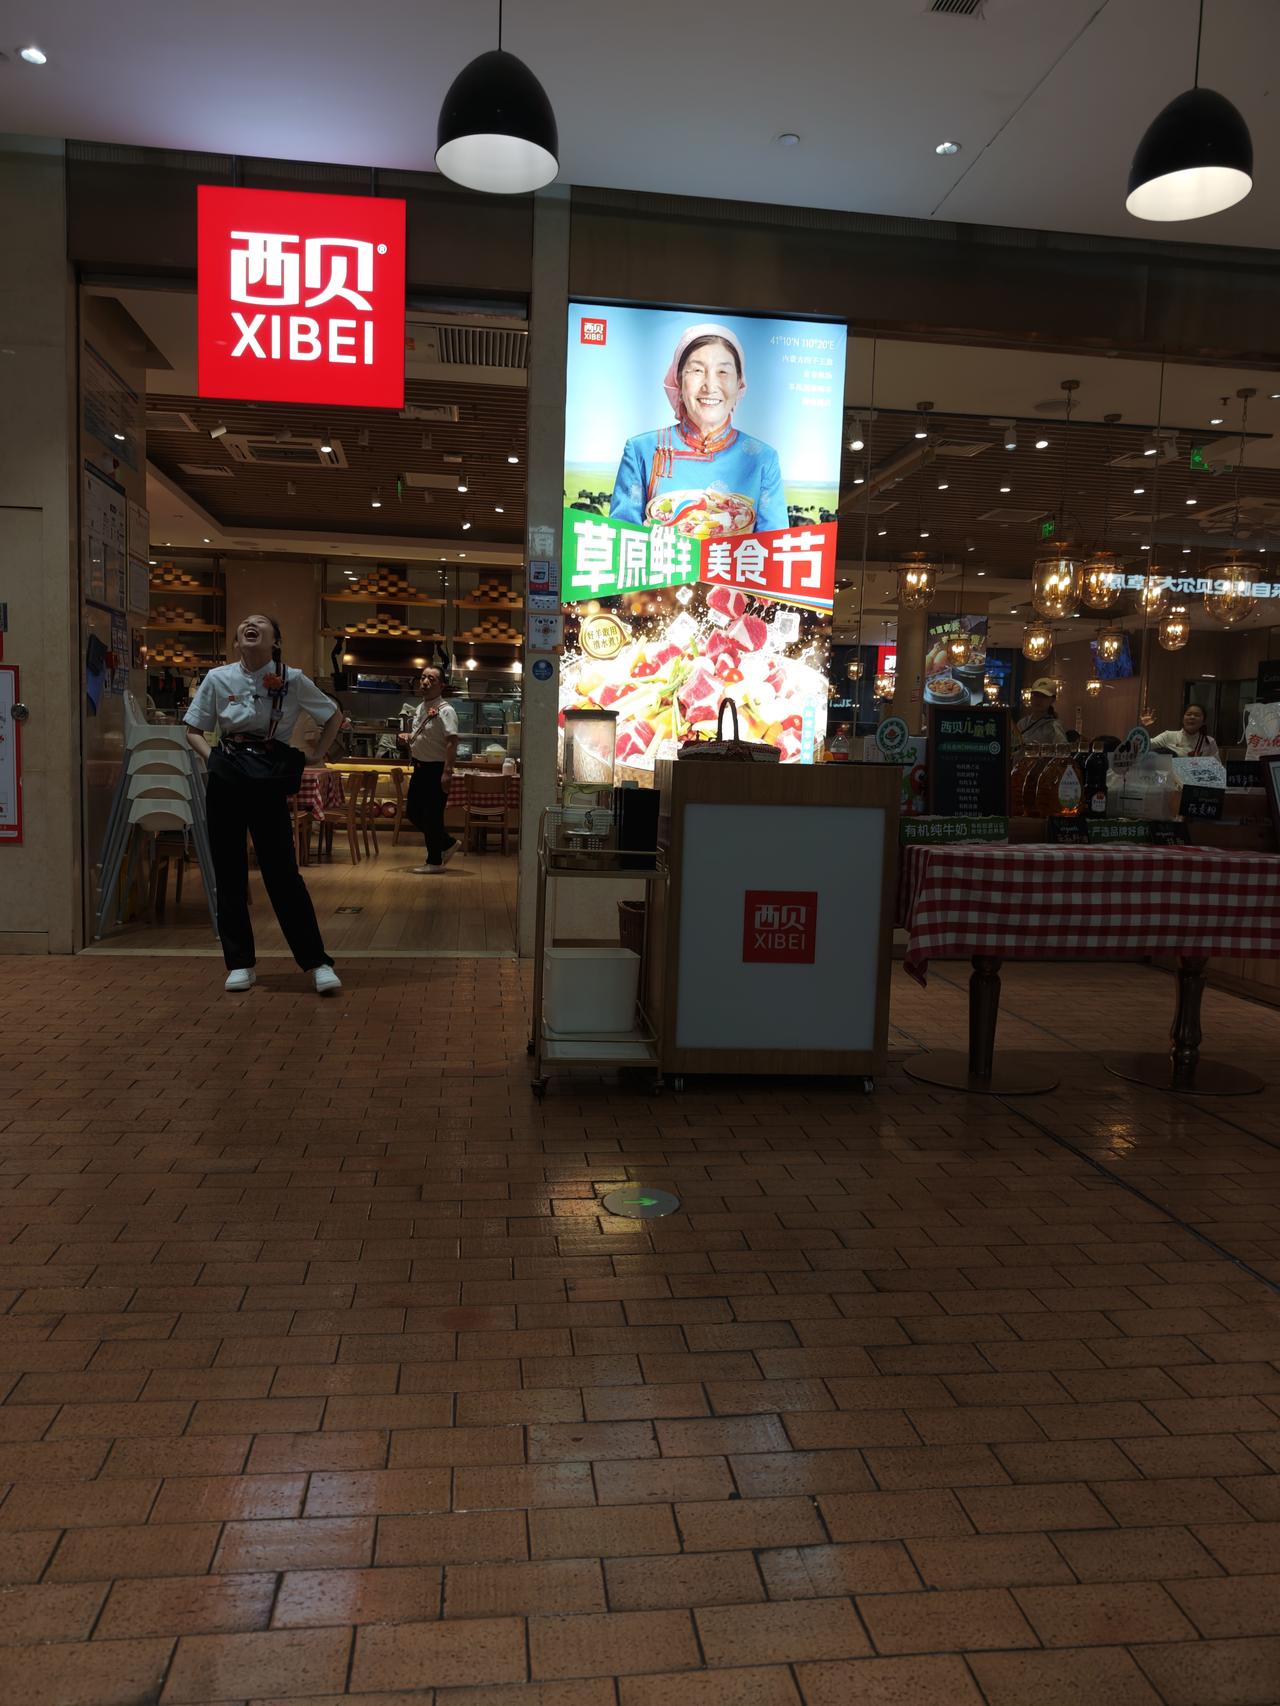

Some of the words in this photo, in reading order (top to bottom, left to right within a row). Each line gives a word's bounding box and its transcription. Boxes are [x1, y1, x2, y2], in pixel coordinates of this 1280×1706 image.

[230, 231, 374, 311] 西贝
[231, 312, 374, 365] XIBEI
[584, 322, 604, 333] 西贝
[584, 333, 604, 341] XIBEI
[571, 519, 693, 593] 草原鲜
[706, 531, 827, 589] 美食节
[904, 823, 968, 838] 有机纯牛奶
[754, 904, 807, 931] 西贝
[754, 933, 806, 950] XIBEI
